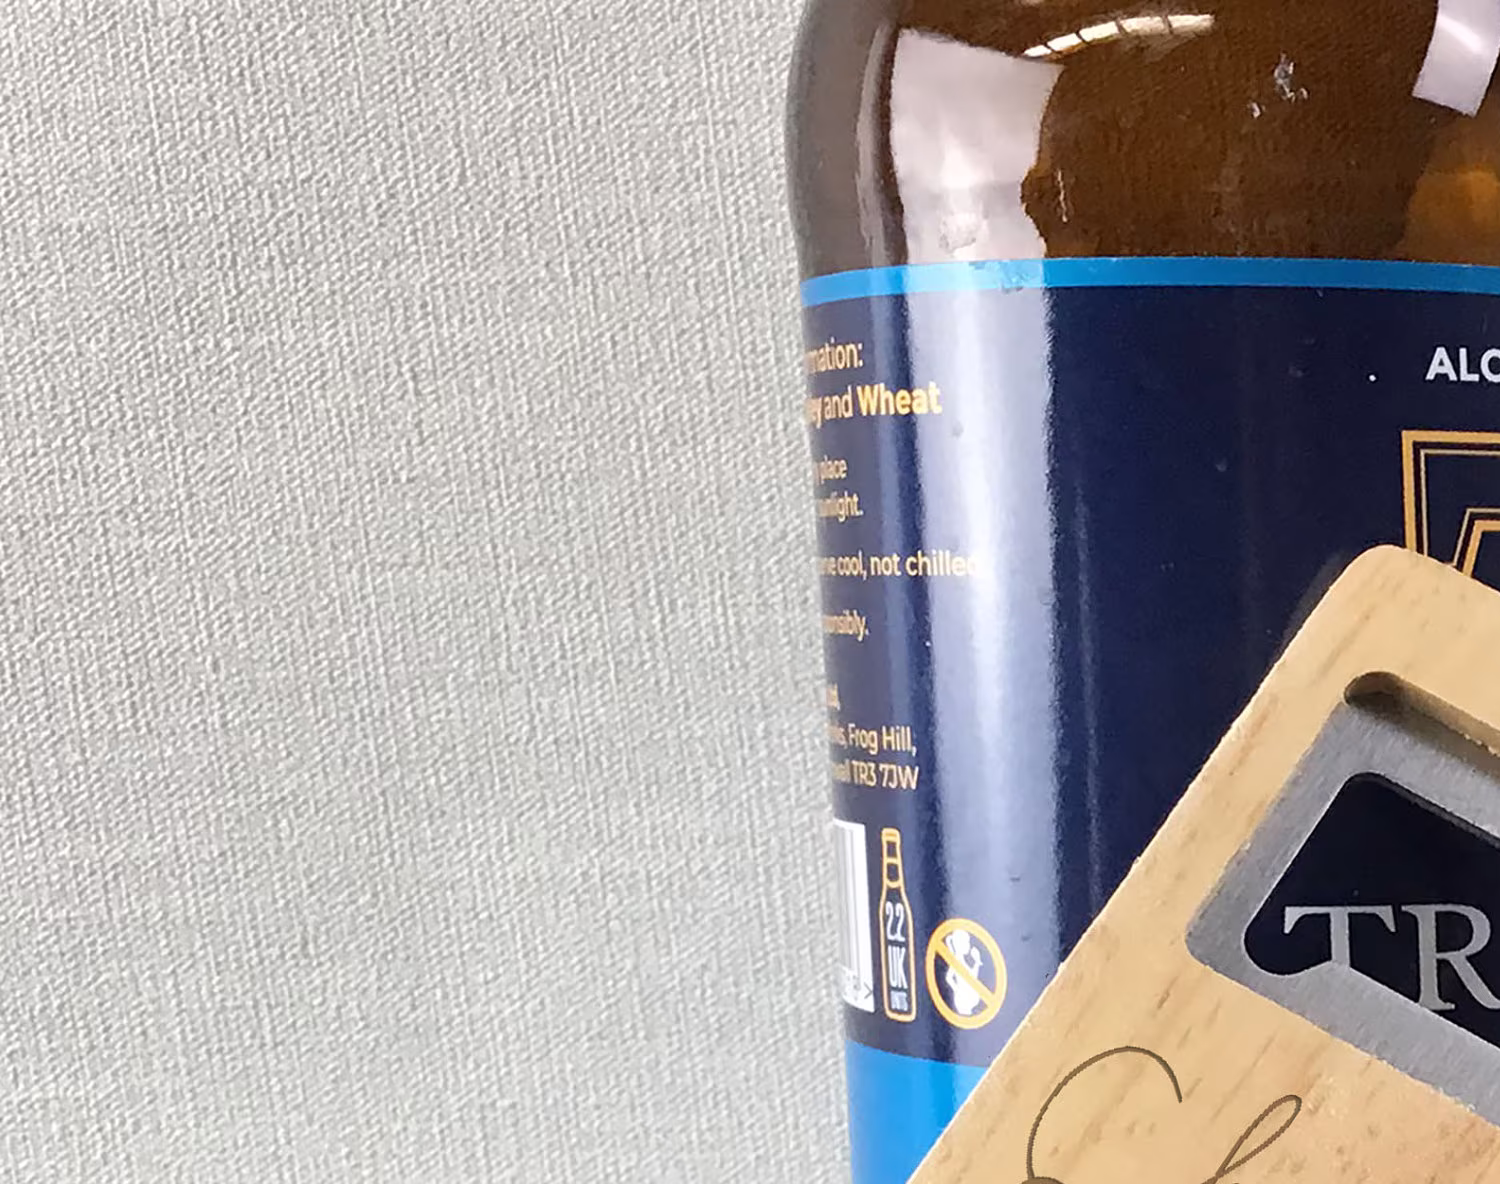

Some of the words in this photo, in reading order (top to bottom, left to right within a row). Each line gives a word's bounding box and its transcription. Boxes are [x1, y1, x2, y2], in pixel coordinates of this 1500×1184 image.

[856, 381, 943, 416] Wheat
[870, 556, 901, 576] not
[848, 723, 878, 755] Frog
[882, 725, 917, 757] Hill,
[888, 946, 908, 989] UK
